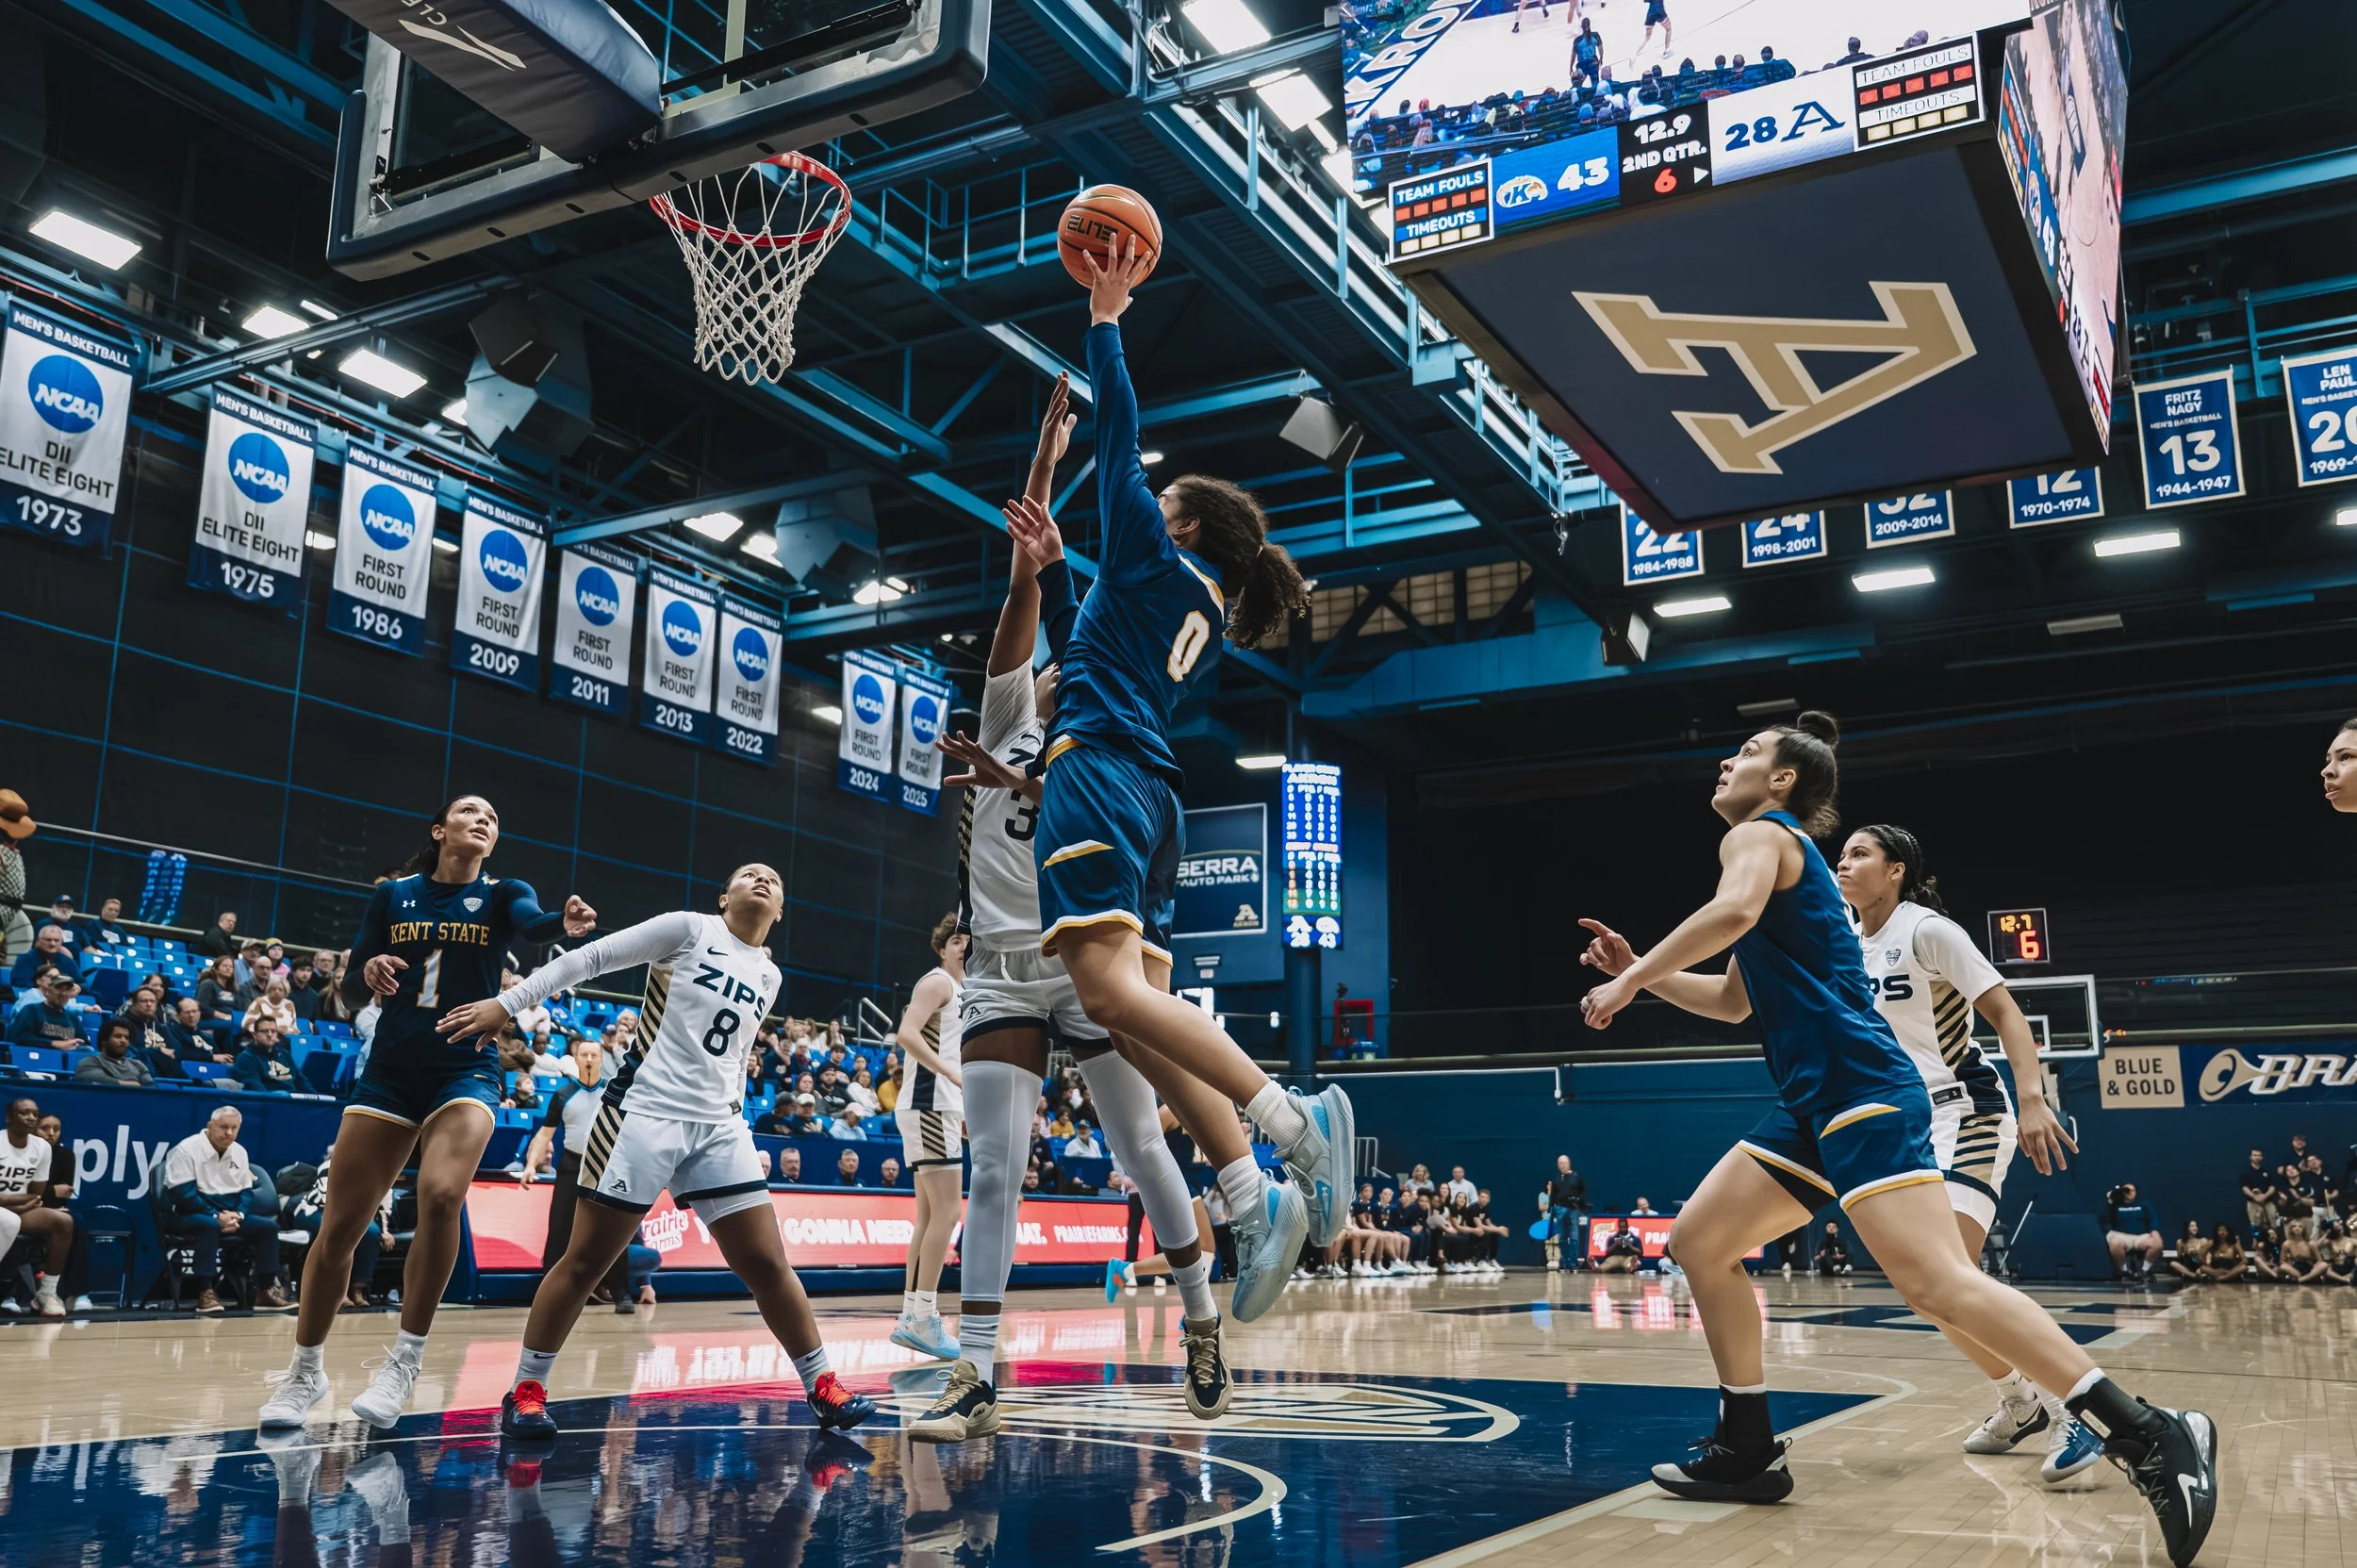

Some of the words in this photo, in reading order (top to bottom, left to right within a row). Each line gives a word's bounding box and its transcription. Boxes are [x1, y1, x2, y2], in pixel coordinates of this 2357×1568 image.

[1862, 63, 1905, 84] TEAM
[1913, 46, 1969, 67] FOULS
[1875, 91, 1961, 122] TIMEOUTS
[1634, 114, 1691, 144] 12.9
[1724, 116, 1779, 152] 28
[1780, 100, 1846, 142] A
[1622, 150, 1661, 173] 2ND
[1662, 140, 1707, 163] QTR.
[1396, 183, 1435, 205] TEAM
[1439, 171, 1484, 194] FOULS
[1557, 157, 1609, 192] 43
[1654, 168, 1677, 193] 6
[1066, 214, 1119, 243] ELITE
[1407, 210, 1476, 238] TIMEOUTS
[13, 310, 54, 338] MEN'S
[54, 327, 131, 368] BASKETBALL
[1571, 280, 1977, 475] A
[2319, 375, 2357, 391] PAUL
[2322, 363, 2351, 379] LEN
[34, 383, 100, 425] NCAA
[2165, 388, 2202, 405] FRITZ
[2167, 400, 2202, 417] NAGY
[2301, 394, 2327, 405] MEN'S
[215, 392, 249, 417] MEN'S
[248, 406, 313, 442] BASKETBALL
[2150, 420, 2174, 430] MEN'S
[2173, 412, 2223, 428] BASKETBALL
[45, 440, 72, 465] DII
[2158, 429, 2221, 475] 13
[0, 447, 52, 481] ELITE
[55, 467, 114, 499] EIGHT
[233, 458, 288, 493] NCAA
[349, 446, 378, 470] MEN'S
[377, 459, 435, 491] BASKETBALL
[2155, 475, 2232, 498] 1944-1947
[16, 494, 83, 536] 1973
[468, 496, 495, 516] MEN'S
[2019, 495, 2091, 518] 1970-1974
[244, 511, 265, 532] DII
[365, 508, 415, 541] NCAA
[1875, 513, 1943, 536] 2009-2014
[201, 517, 249, 548] ELITE
[252, 535, 300, 563] EIGHT
[1751, 536, 1817, 558] 1998-2001
[363, 553, 405, 580] FIRST
[484, 553, 526, 584] NCAA
[589, 545, 635, 572] BASKETBALL
[1631, 555, 1694, 576] 1984-1988
[221, 561, 275, 599] 1975
[354, 570, 407, 600] ROUND
[482, 596, 519, 620] FIRST
[579, 589, 618, 616] NCAA
[352, 604, 404, 640] 1986
[476, 612, 520, 639] ROUND
[665, 620, 701, 646] NCAA
[578, 629, 611, 653] FIRST
[1167, 609, 1211, 684] 0
[470, 643, 520, 676] 2009
[573, 645, 614, 670] ROUND
[736, 648, 768, 672] NCAA
[665, 661, 695, 682] FIRST
[571, 676, 610, 706] 2011
[659, 675, 696, 699] ROUND
[735, 685, 763, 705] FIRST
[731, 699, 764, 721] ROUND
[855, 693, 884, 716] NCAA
[655, 704, 694, 733] 2013
[726, 726, 764, 755] 2022
[854, 729, 879, 747] FIRST
[851, 742, 882, 762] ROUND
[910, 748, 931, 766] FIRST
[849, 767, 880, 792] 2024
[903, 784, 928, 808] 2025
[1177, 855, 1260, 879] SERRA
[1179, 877, 1215, 887] AUTO
[1216, 873, 1251, 884] PARK
[1234, 904, 1260, 921] A
[2000, 914, 2032, 933] 12.7
[390, 920, 434, 945] KENT
[437, 920, 491, 947] STATE
[2019, 930, 2039, 959] 6
[416, 948, 444, 1010] 1
[692, 963, 766, 1023] ZIPS
[702, 1007, 741, 1058] 8
[2115, 1058, 2164, 1075] BLUE
[2106, 1081, 2120, 1097] &
[2126, 1079, 2176, 1096] GOLD
[643, 1210, 687, 1240] rairie
[783, 1217, 867, 1245] GONNA
[865, 1219, 916, 1245] NEED
